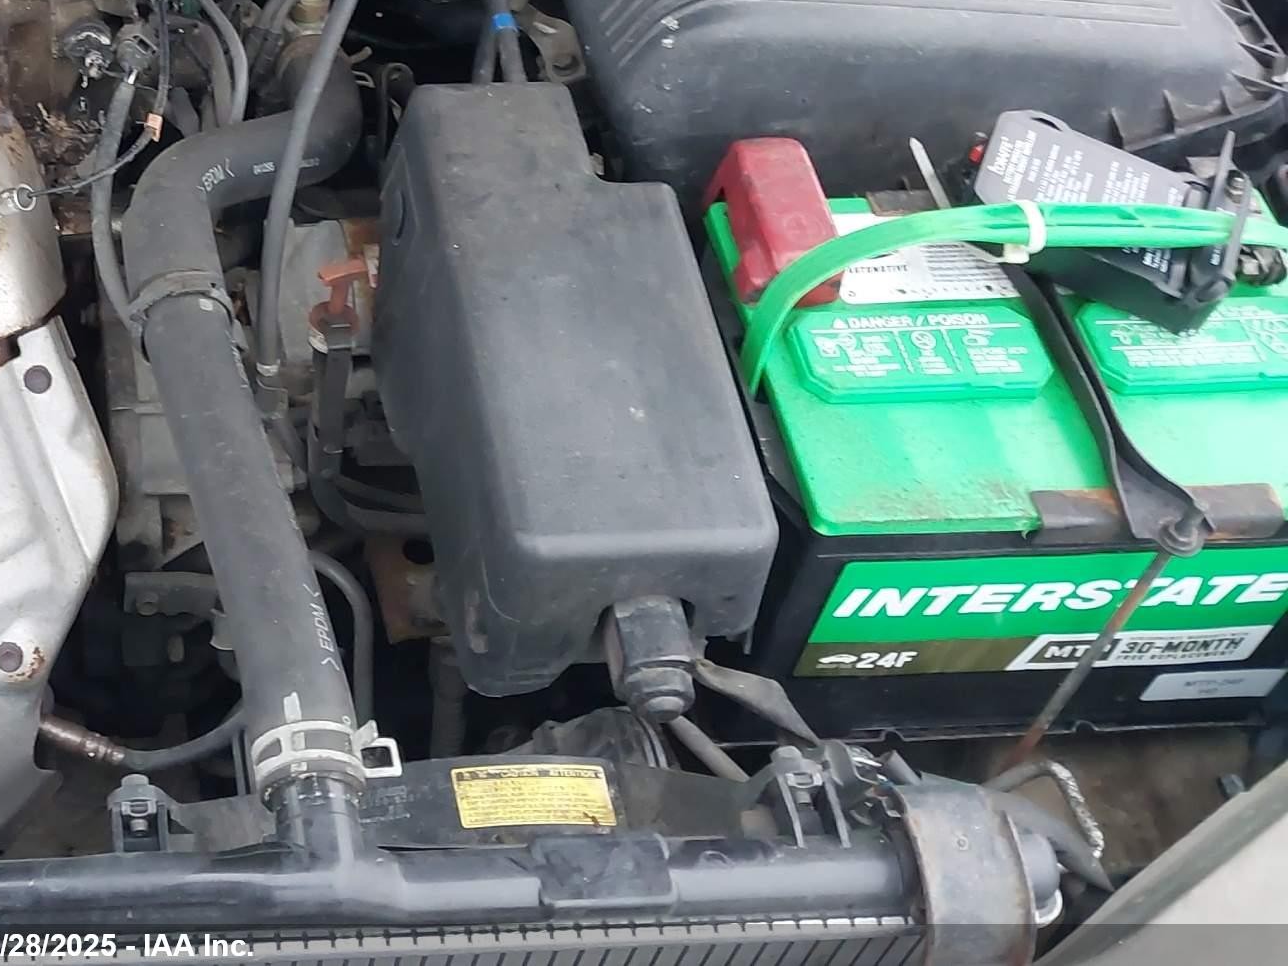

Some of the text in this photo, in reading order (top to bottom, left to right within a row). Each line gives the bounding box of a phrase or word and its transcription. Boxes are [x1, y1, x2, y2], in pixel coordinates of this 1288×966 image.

[848, 313, 914, 330] DANGER
[926, 312, 990, 327] POISON
[1120, 636, 1246, 654] 30-MONTH
[855, 650, 918, 669] 24F
